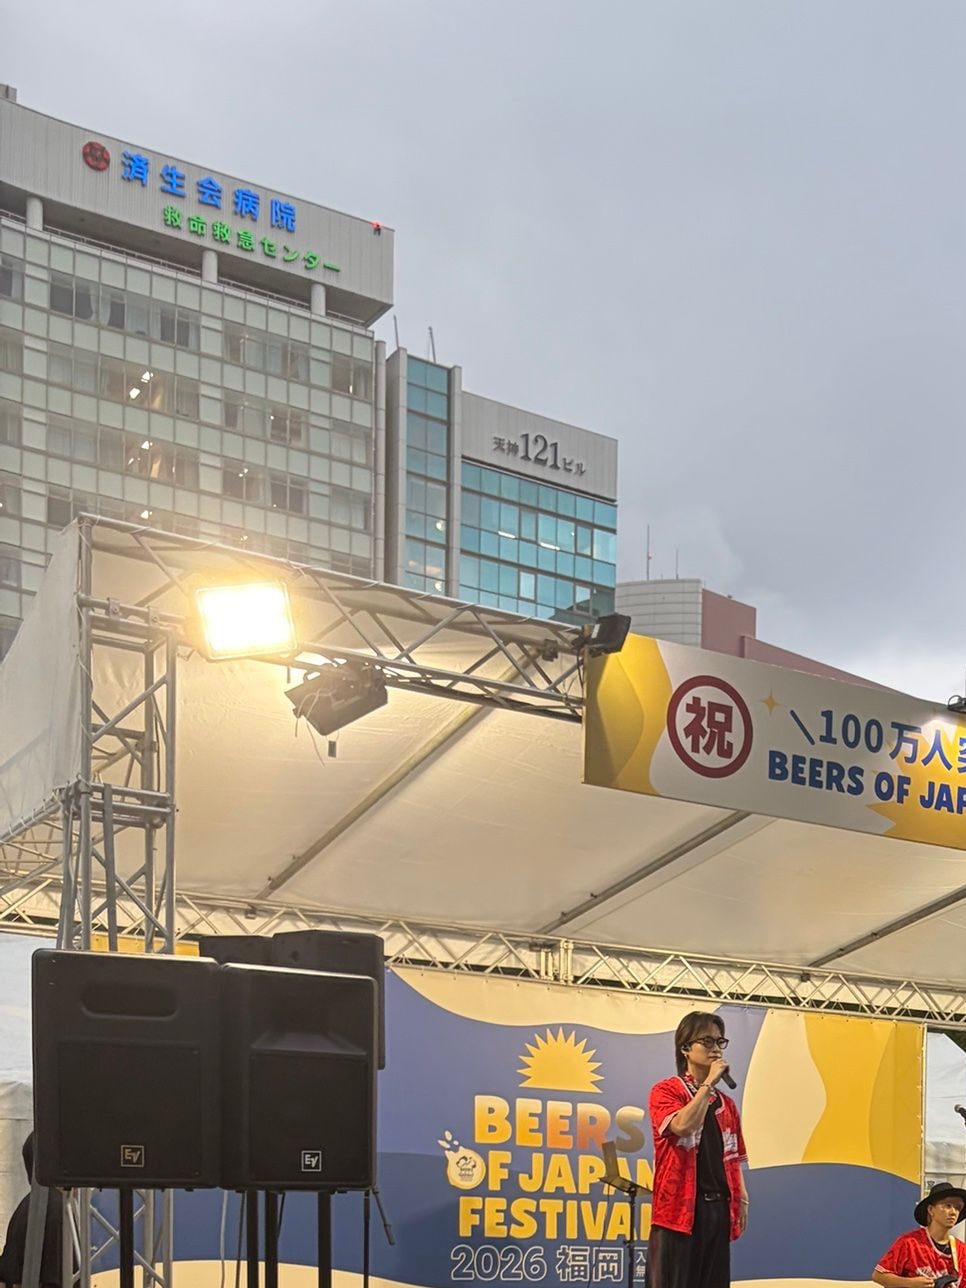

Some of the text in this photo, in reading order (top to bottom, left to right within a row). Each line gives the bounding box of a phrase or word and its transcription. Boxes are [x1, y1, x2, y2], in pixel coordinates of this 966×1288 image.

[120, 150, 297, 233] 済生会病院
[163, 205, 341, 273] 救命救急センター
[492, 432, 587, 477] 天神121ビル
[683, 695, 734, 760] 祝
[768, 750, 865, 796] BEERS
[874, 771, 912, 804] OF
[474, 1094, 646, 1153] BEERS
[450, 1244, 625, 1283] 2026 福岡
